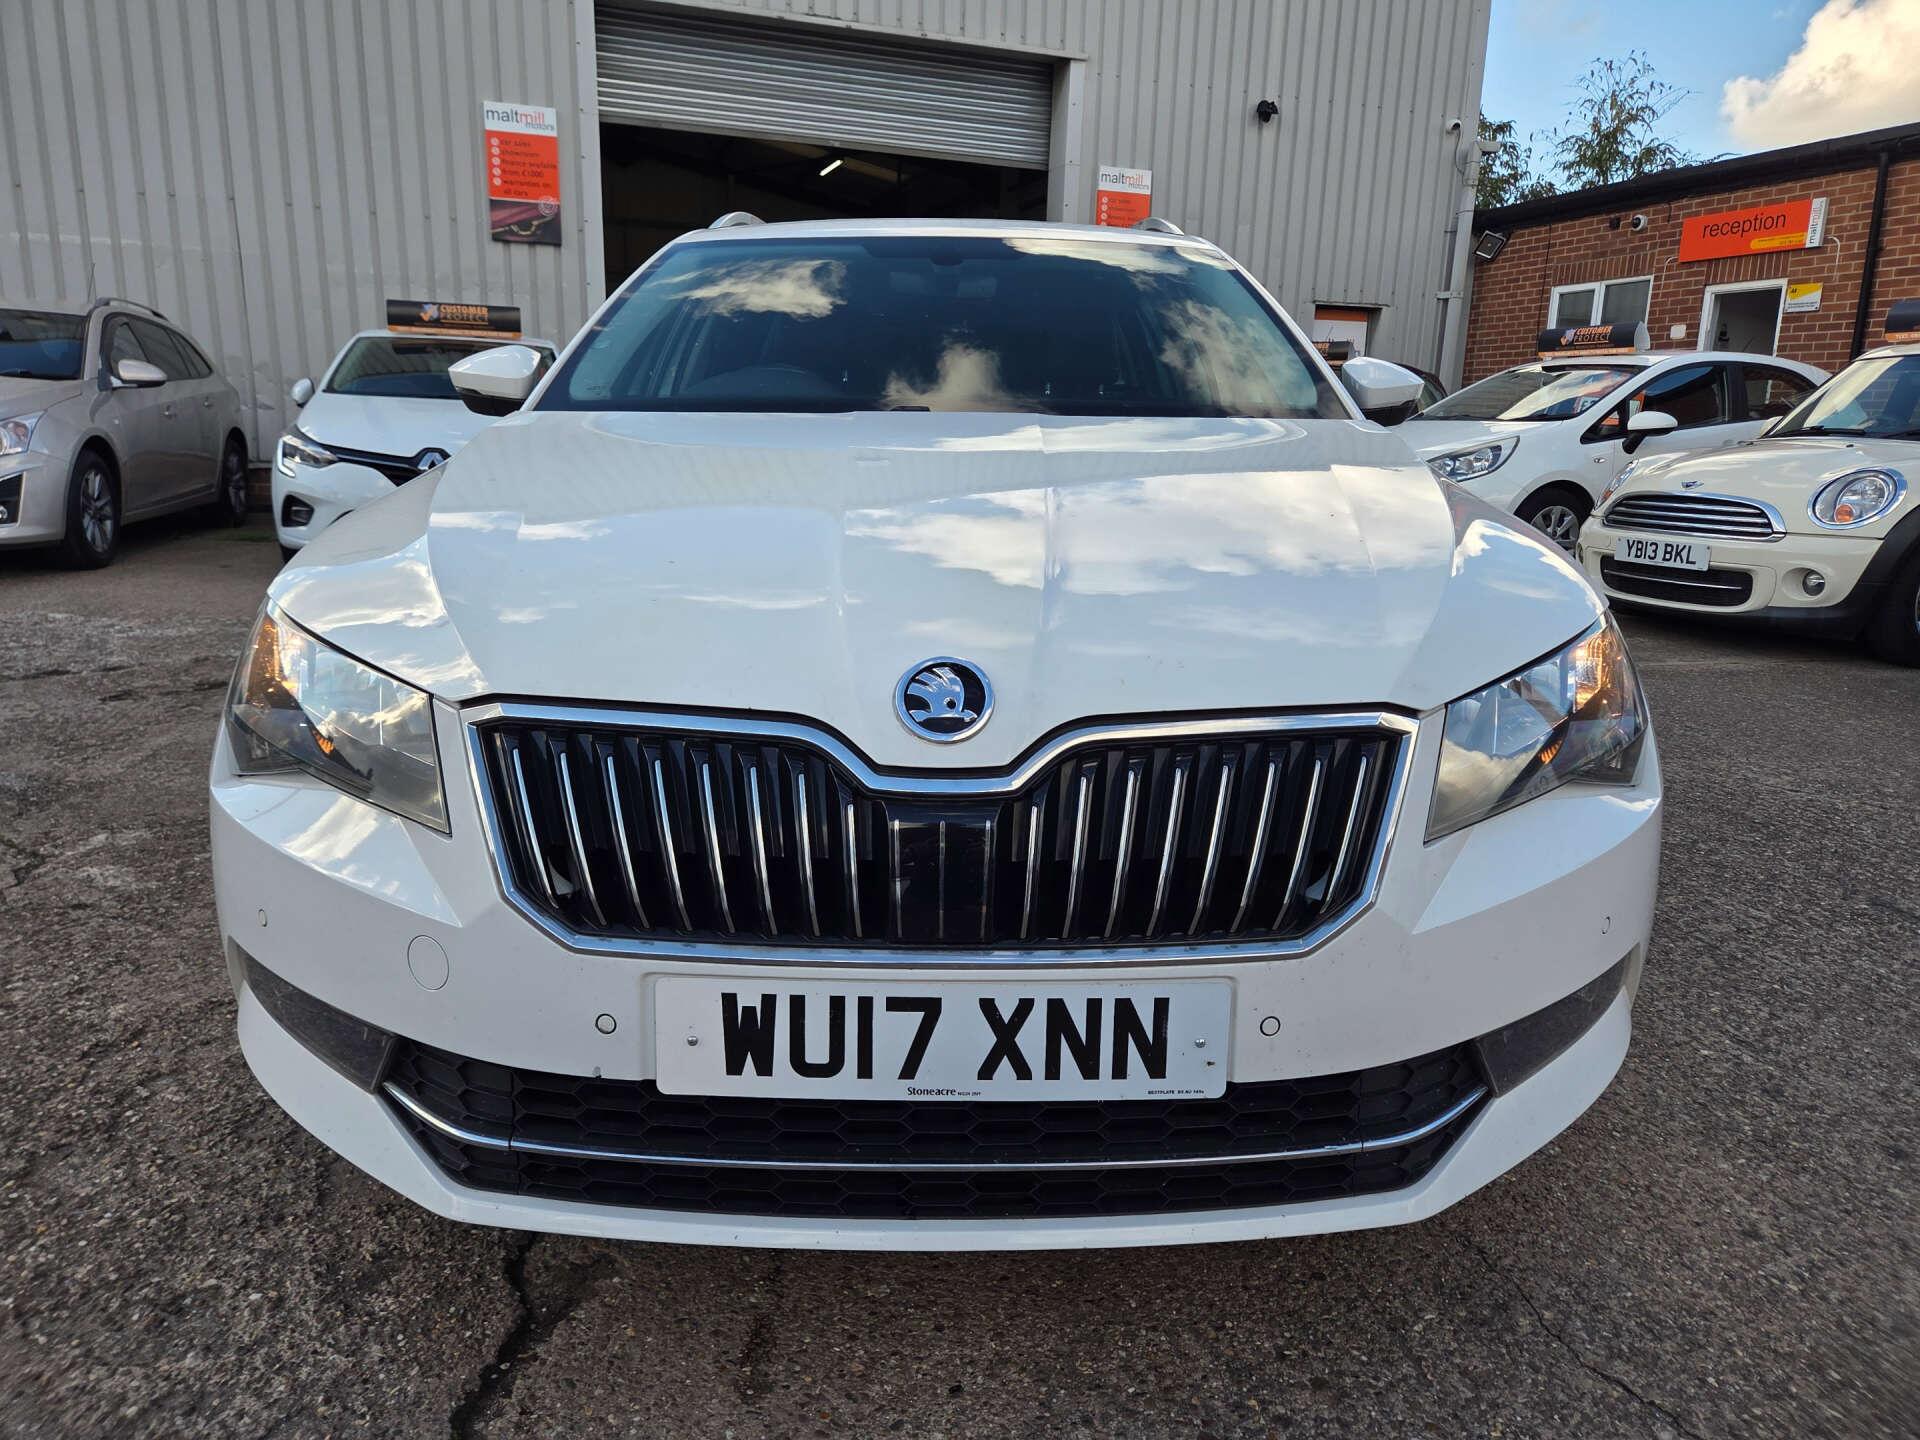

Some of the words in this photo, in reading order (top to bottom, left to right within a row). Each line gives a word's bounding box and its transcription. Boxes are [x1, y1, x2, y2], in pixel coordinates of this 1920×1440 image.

[486, 108, 545, 124] maltmill
[1101, 172, 1144, 184] maltmill
[1702, 212, 1787, 239] reception
[440, 304, 488, 315] CUSTOMER
[1577, 325, 1613, 335] CUSTOMER
[1574, 334, 1609, 343] PROTECT
[1627, 539, 1659, 560] YB13
[1662, 543, 1697, 565] BKL
[721, 992, 943, 1080] WU17
[977, 996, 1171, 1081] XNN
[907, 1086, 956, 1096] Stoneacre
